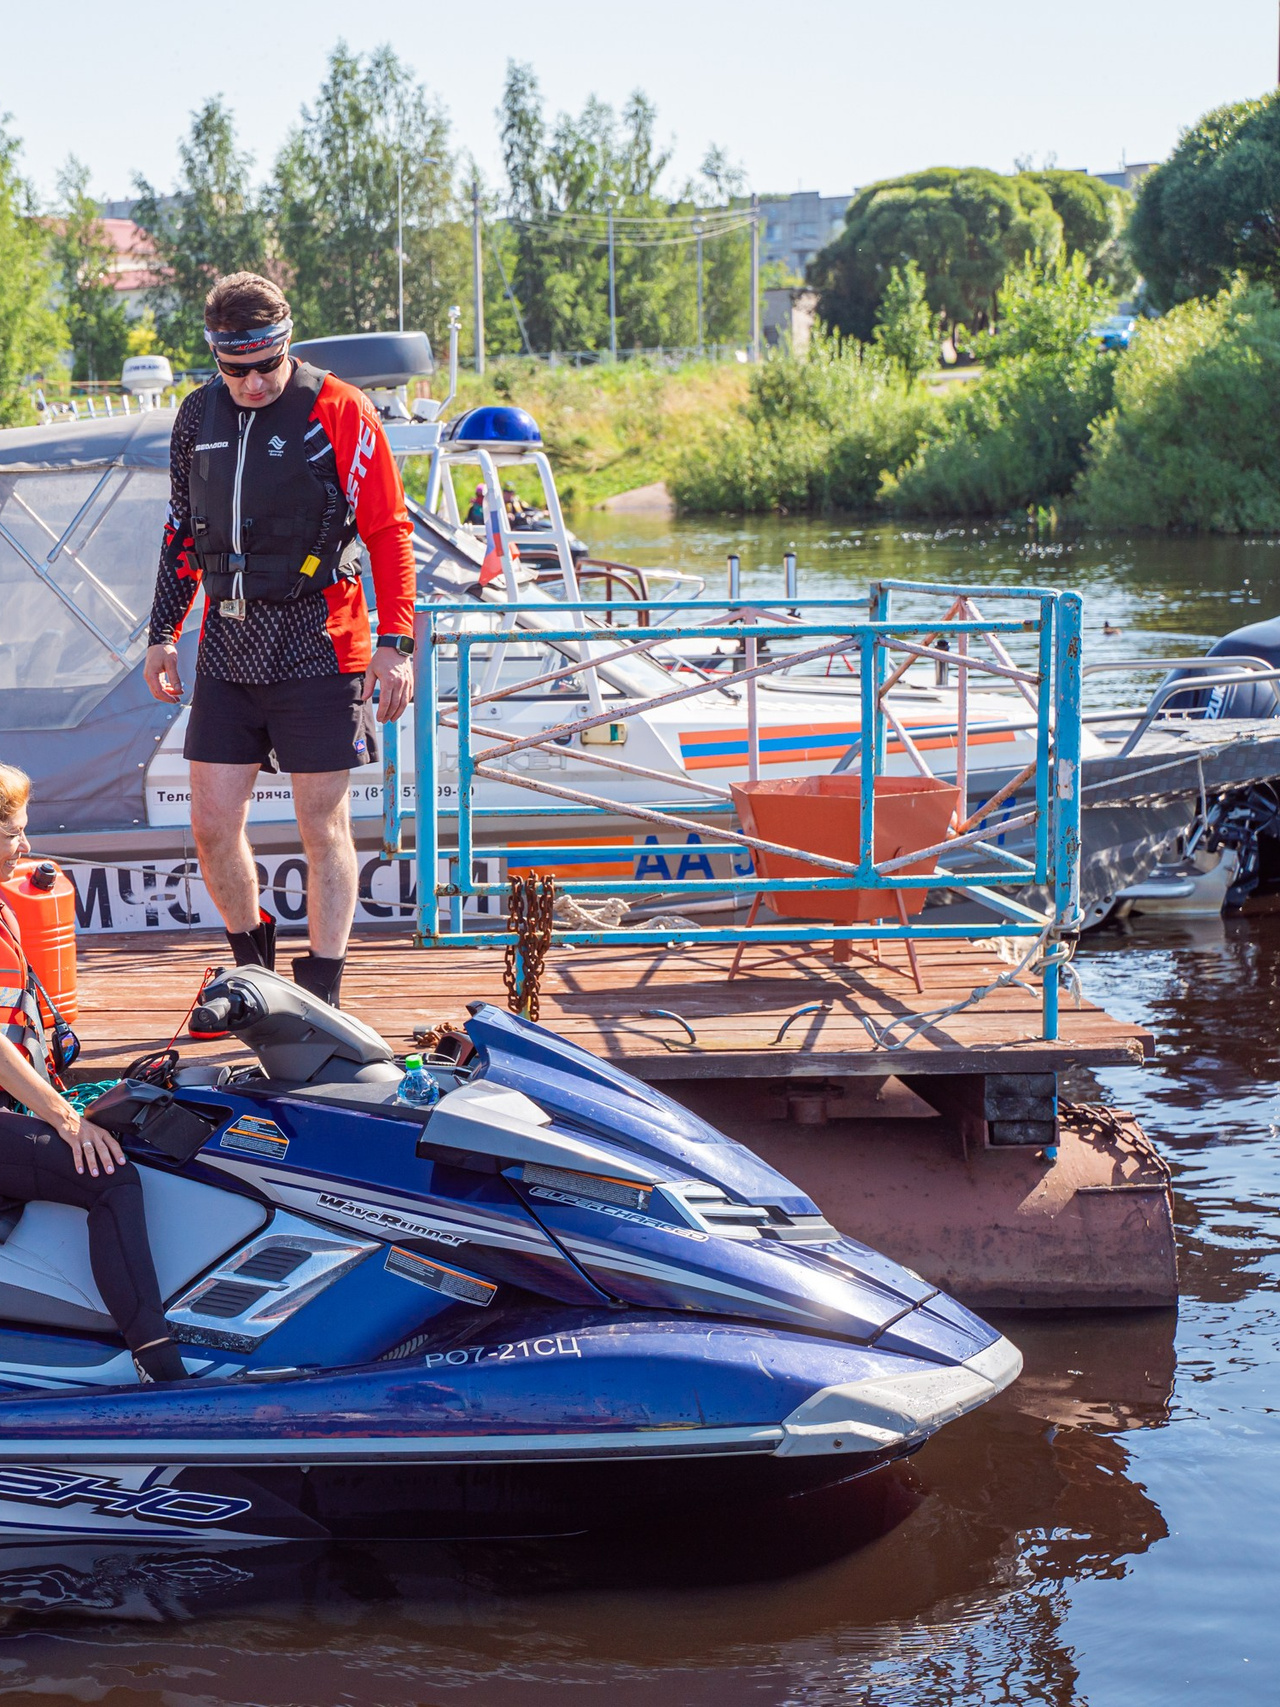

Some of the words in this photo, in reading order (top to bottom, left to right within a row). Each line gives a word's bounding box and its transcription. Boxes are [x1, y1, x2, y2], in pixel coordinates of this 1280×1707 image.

[1204, 685, 1228, 719] ZUK
[156, 791, 192, 802] Теле
[61, 862, 202, 929] МЧС
[317, 1193, 471, 1247] WaveRunner
[529, 1186, 709, 1243] SUPERCHARGED
